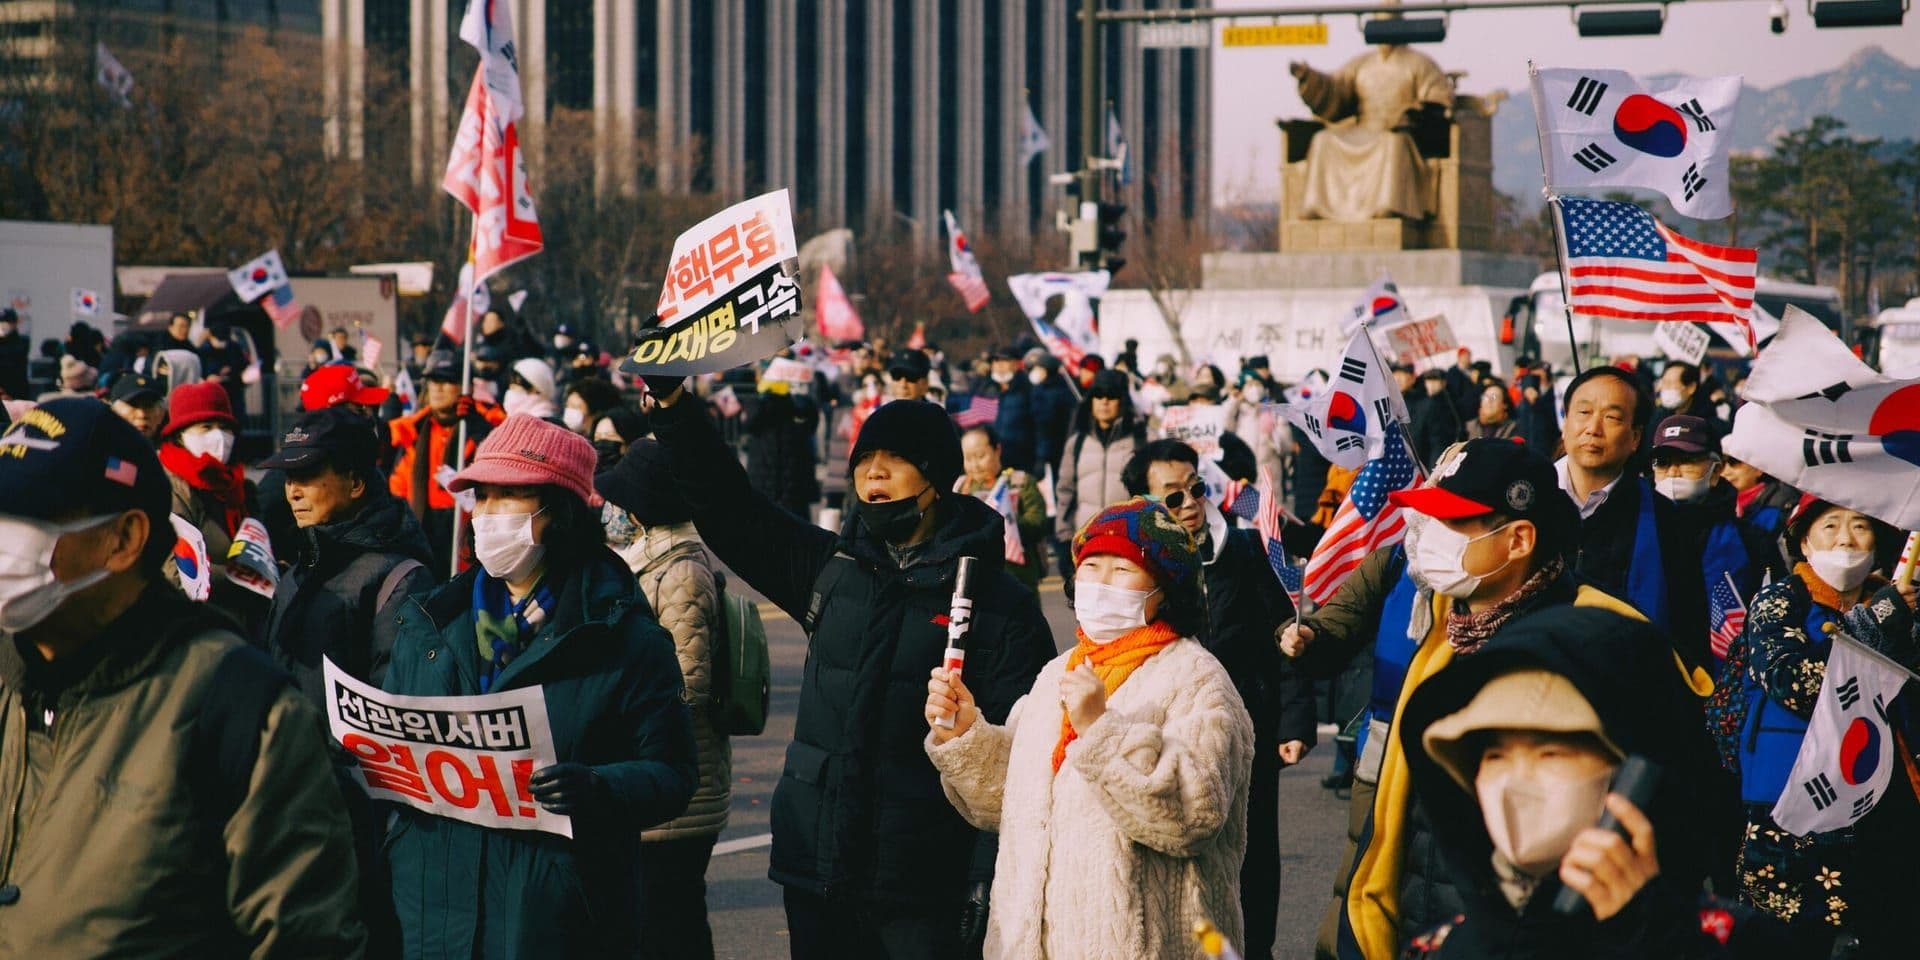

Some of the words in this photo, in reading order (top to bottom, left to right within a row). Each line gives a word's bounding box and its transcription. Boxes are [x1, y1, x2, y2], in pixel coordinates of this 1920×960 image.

[633, 301, 737, 365] 이재명
[738, 271, 797, 335] 구속
[339, 688, 525, 748] 선관위서버
[342, 733, 537, 818] 열어!
